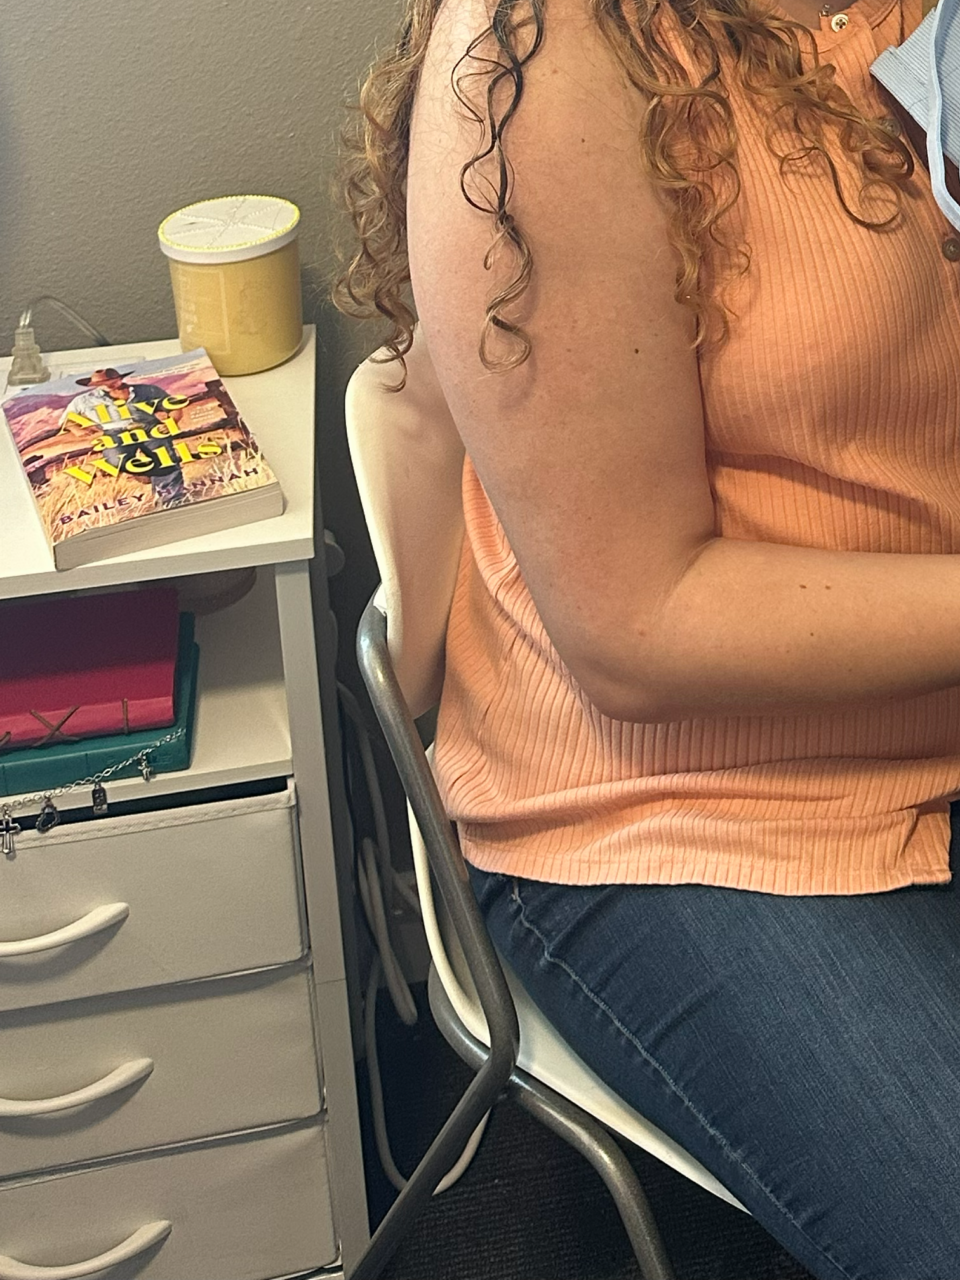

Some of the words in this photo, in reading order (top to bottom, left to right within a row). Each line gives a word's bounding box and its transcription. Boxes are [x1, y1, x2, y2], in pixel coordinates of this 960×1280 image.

[59, 394, 191, 436] Alive
[90, 416, 184, 452] and
[63, 441, 223, 486] Wells
[59, 493, 146, 525] BAILEY
[156, 467, 259, 497] HANNAH
